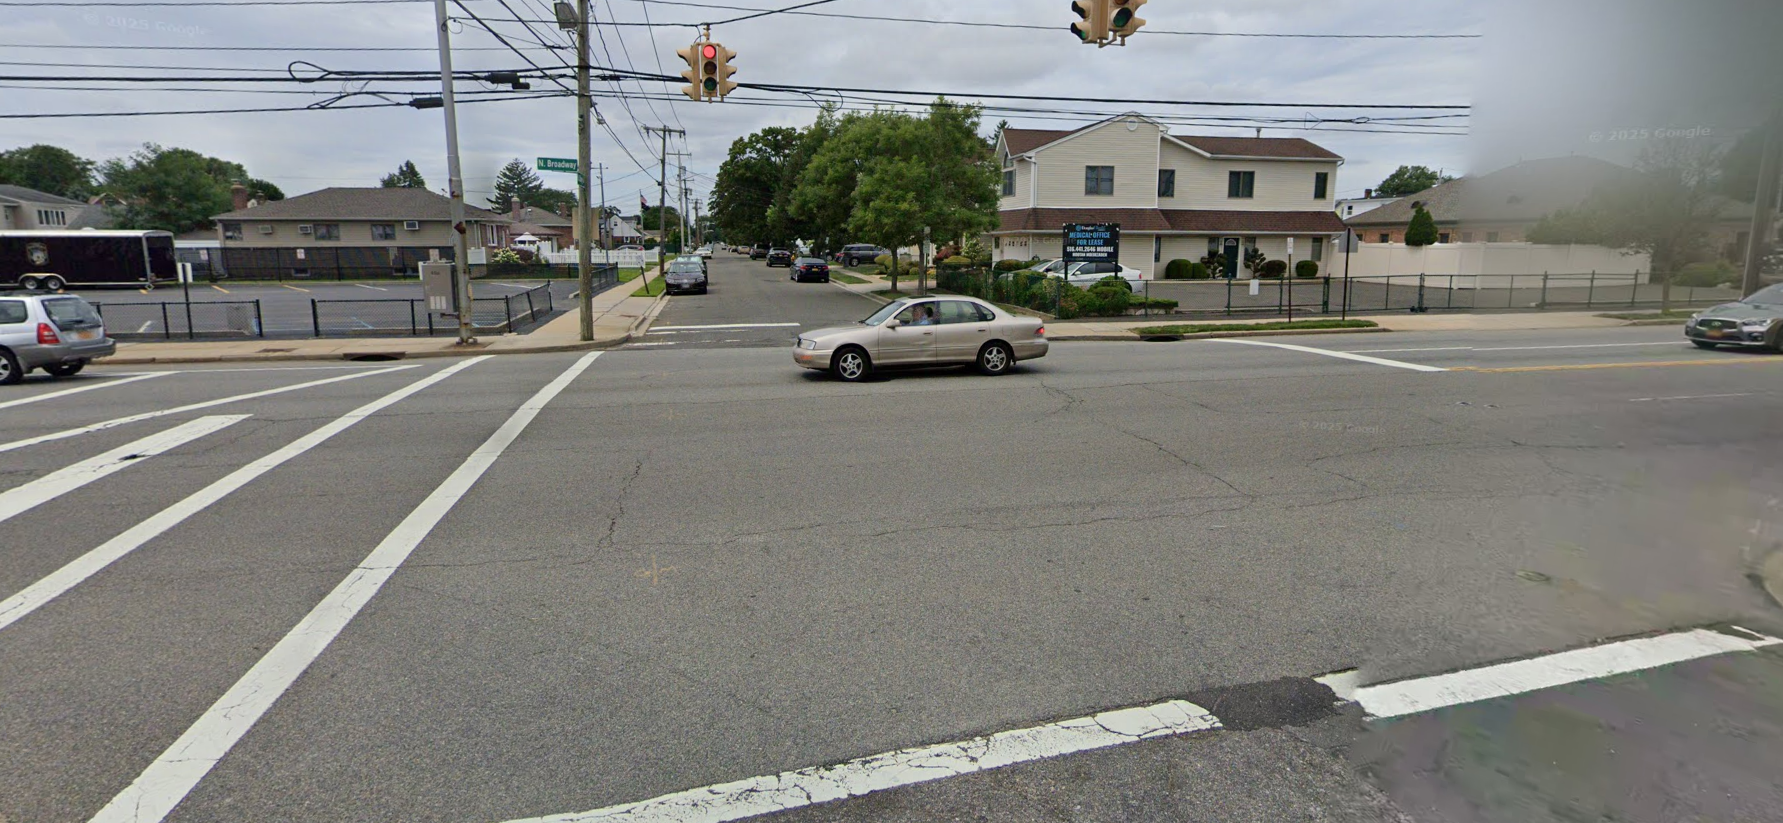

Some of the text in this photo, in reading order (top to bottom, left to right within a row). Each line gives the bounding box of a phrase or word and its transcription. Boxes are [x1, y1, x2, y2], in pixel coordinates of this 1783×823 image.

[538, 159, 577, 170] N. Broadway
[1069, 231, 1110, 239] MEDICAL OFFICE
